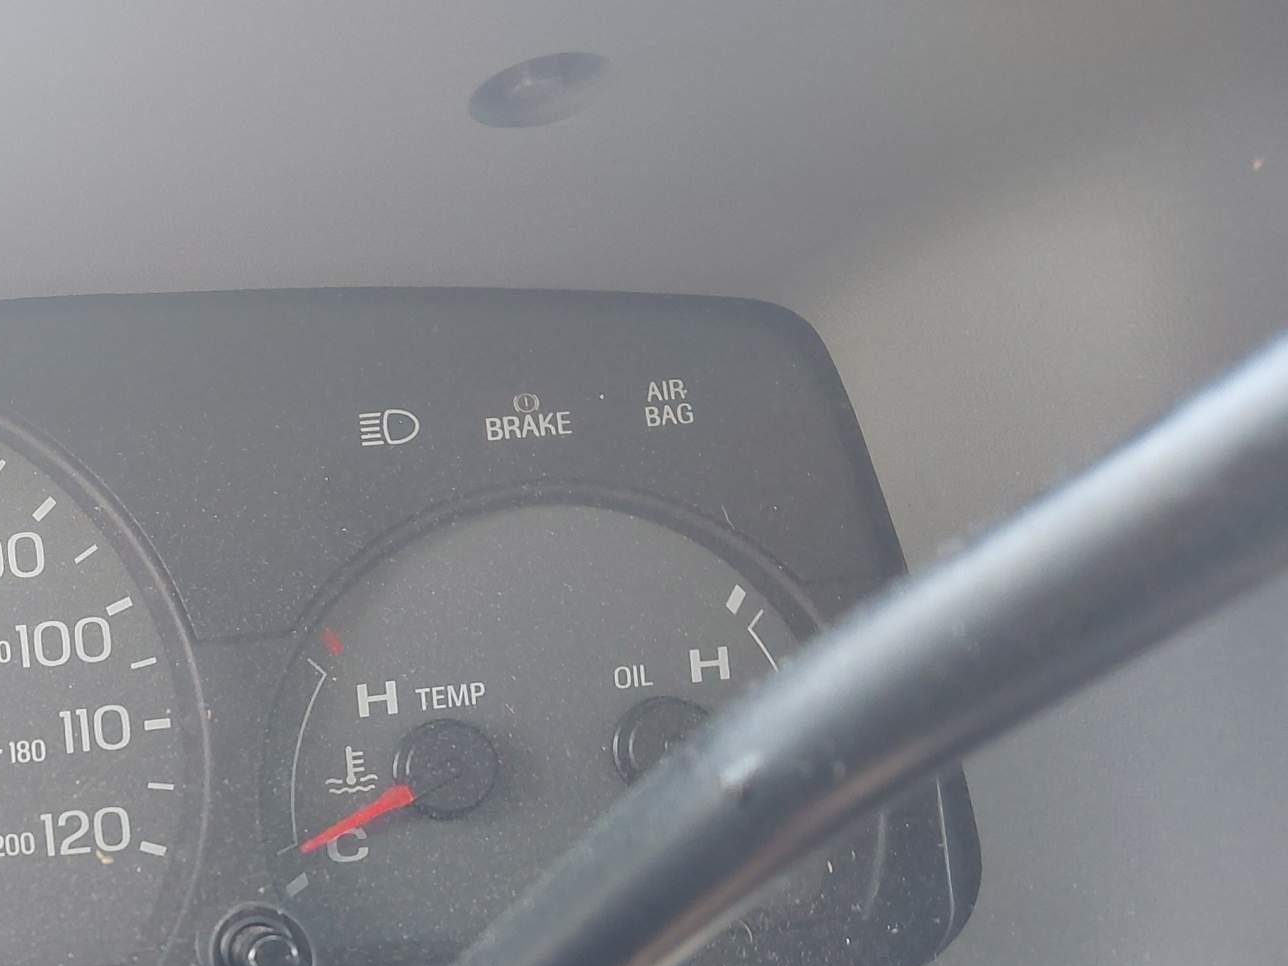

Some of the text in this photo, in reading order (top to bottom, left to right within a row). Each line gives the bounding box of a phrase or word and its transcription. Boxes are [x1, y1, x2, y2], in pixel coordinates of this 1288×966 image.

[647, 379, 685, 402] AIR
[485, 411, 573, 442] BRAKE
[645, 403, 694, 427] BAG
[15, 617, 111, 668] 100
[614, 665, 654, 690] OIL
[689, 646, 730, 683] H
[356, 681, 399, 717] H
[415, 682, 486, 711] TEMP
[59, 705, 130, 754] 110
[9, 740, 46, 763] 180
[41, 807, 130, 856] 120
[327, 827, 368, 862] C
